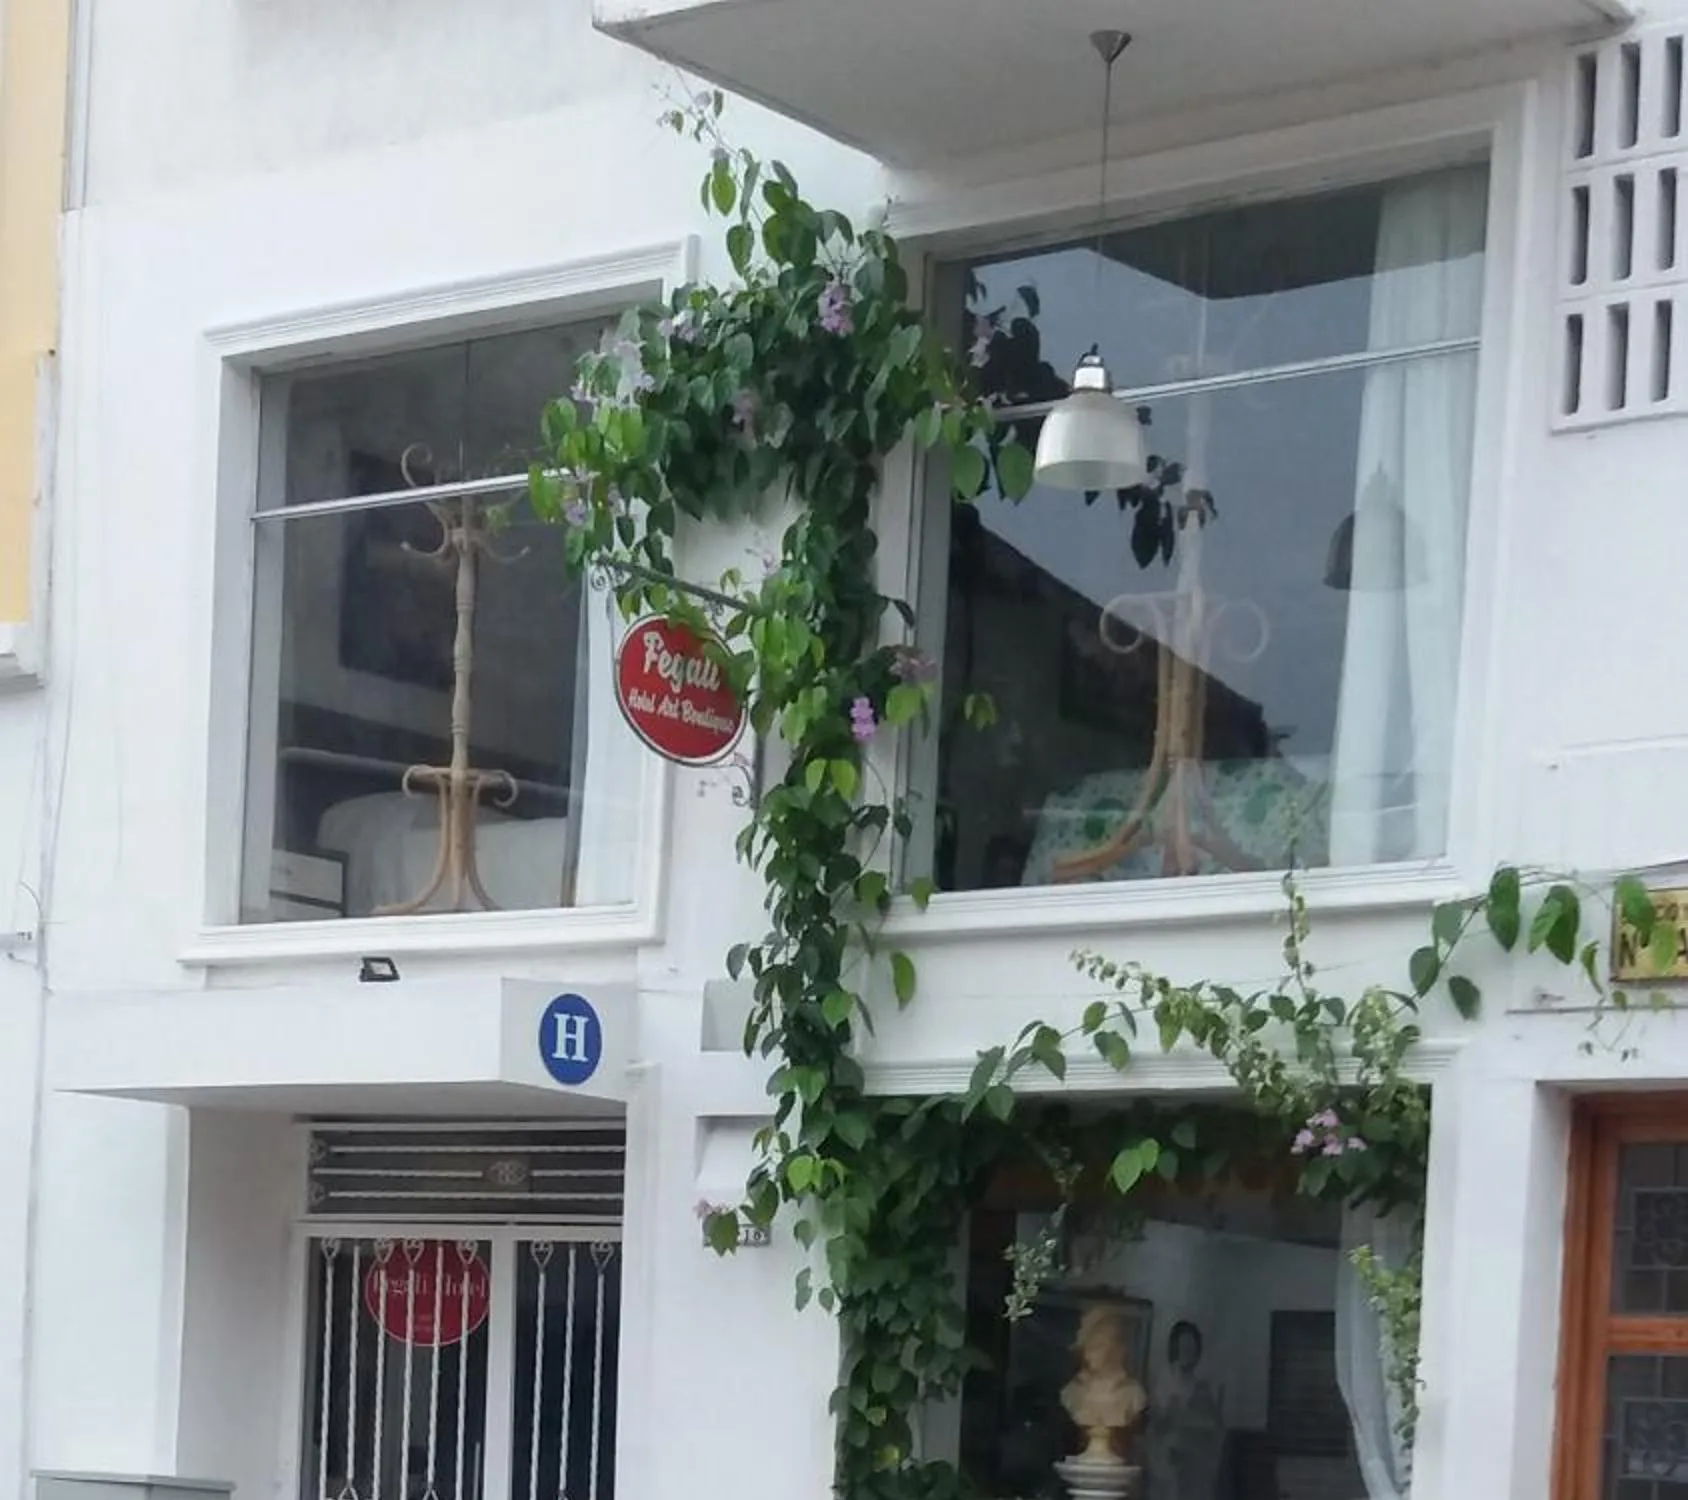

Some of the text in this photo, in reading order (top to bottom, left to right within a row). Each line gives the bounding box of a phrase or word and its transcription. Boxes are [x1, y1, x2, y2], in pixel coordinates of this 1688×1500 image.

[627, 687, 656, 713] Hotel
[657, 696, 680, 719] Art
[552, 1013, 589, 1062] H
